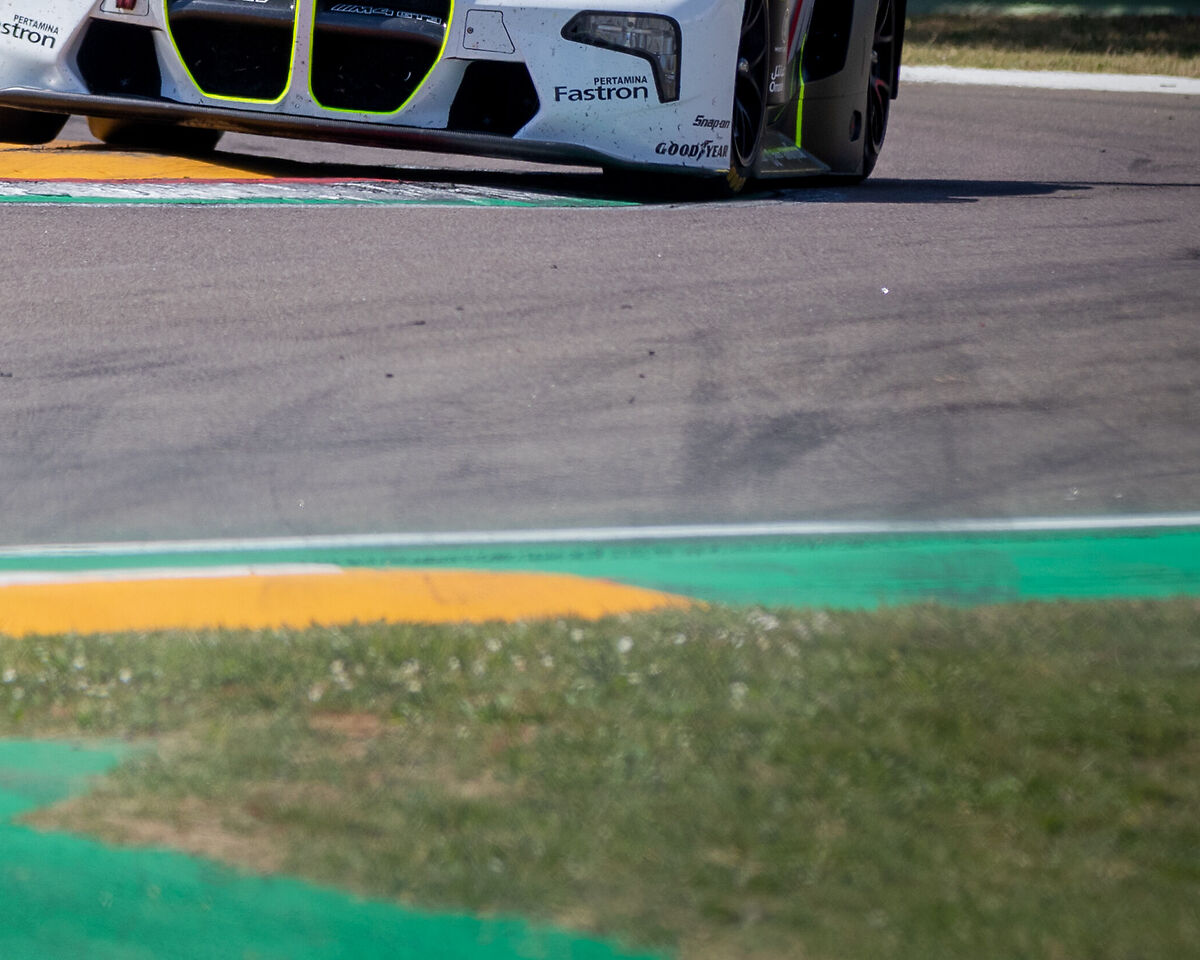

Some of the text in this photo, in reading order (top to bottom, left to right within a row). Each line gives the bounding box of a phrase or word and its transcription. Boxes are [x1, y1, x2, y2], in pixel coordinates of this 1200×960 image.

[13, 14, 60, 35] PERTAMINA
[593, 75, 648, 85] PERTAMINA
[554, 86, 648, 101] Fastron
[692, 115, 731, 130] Snap-on
